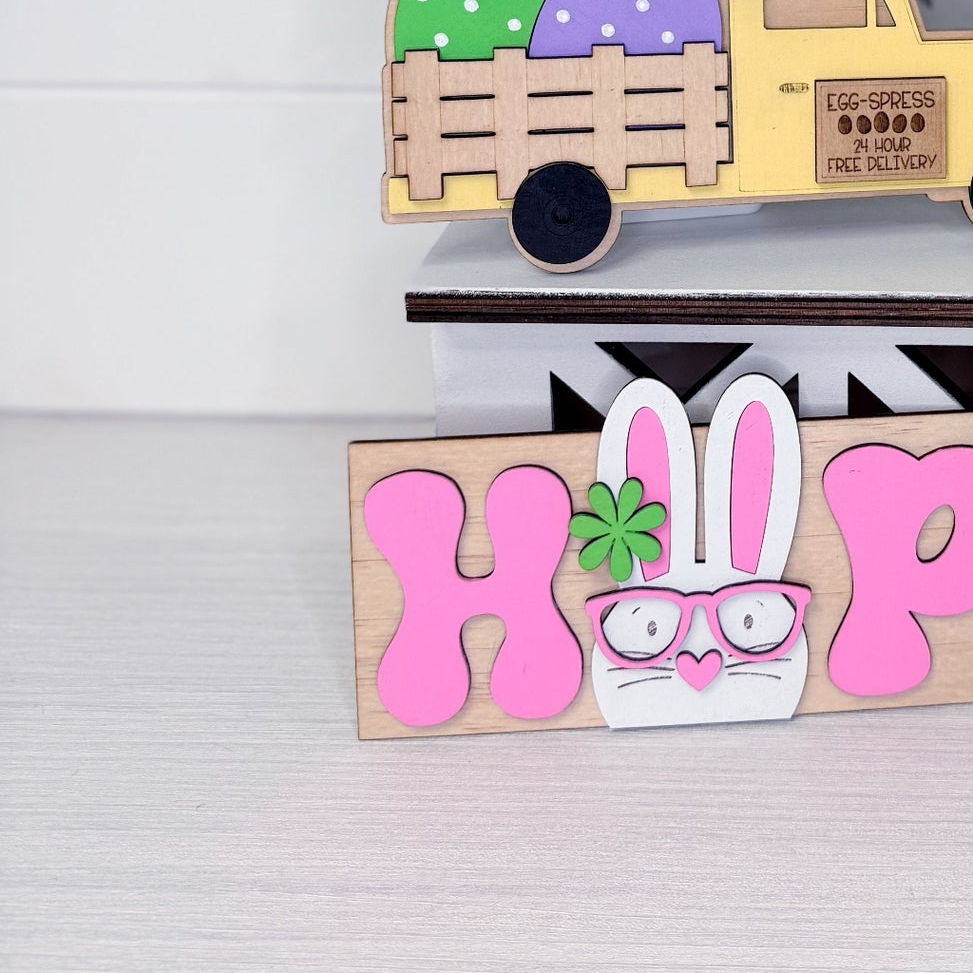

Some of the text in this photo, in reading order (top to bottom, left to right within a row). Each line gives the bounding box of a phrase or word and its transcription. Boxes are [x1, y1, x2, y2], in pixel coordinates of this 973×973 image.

[827, 90, 936, 112] EGG-SPRESS
[853, 136, 912, 154] 24 HOUR
[828, 154, 937, 174] FREE DELIVERY
